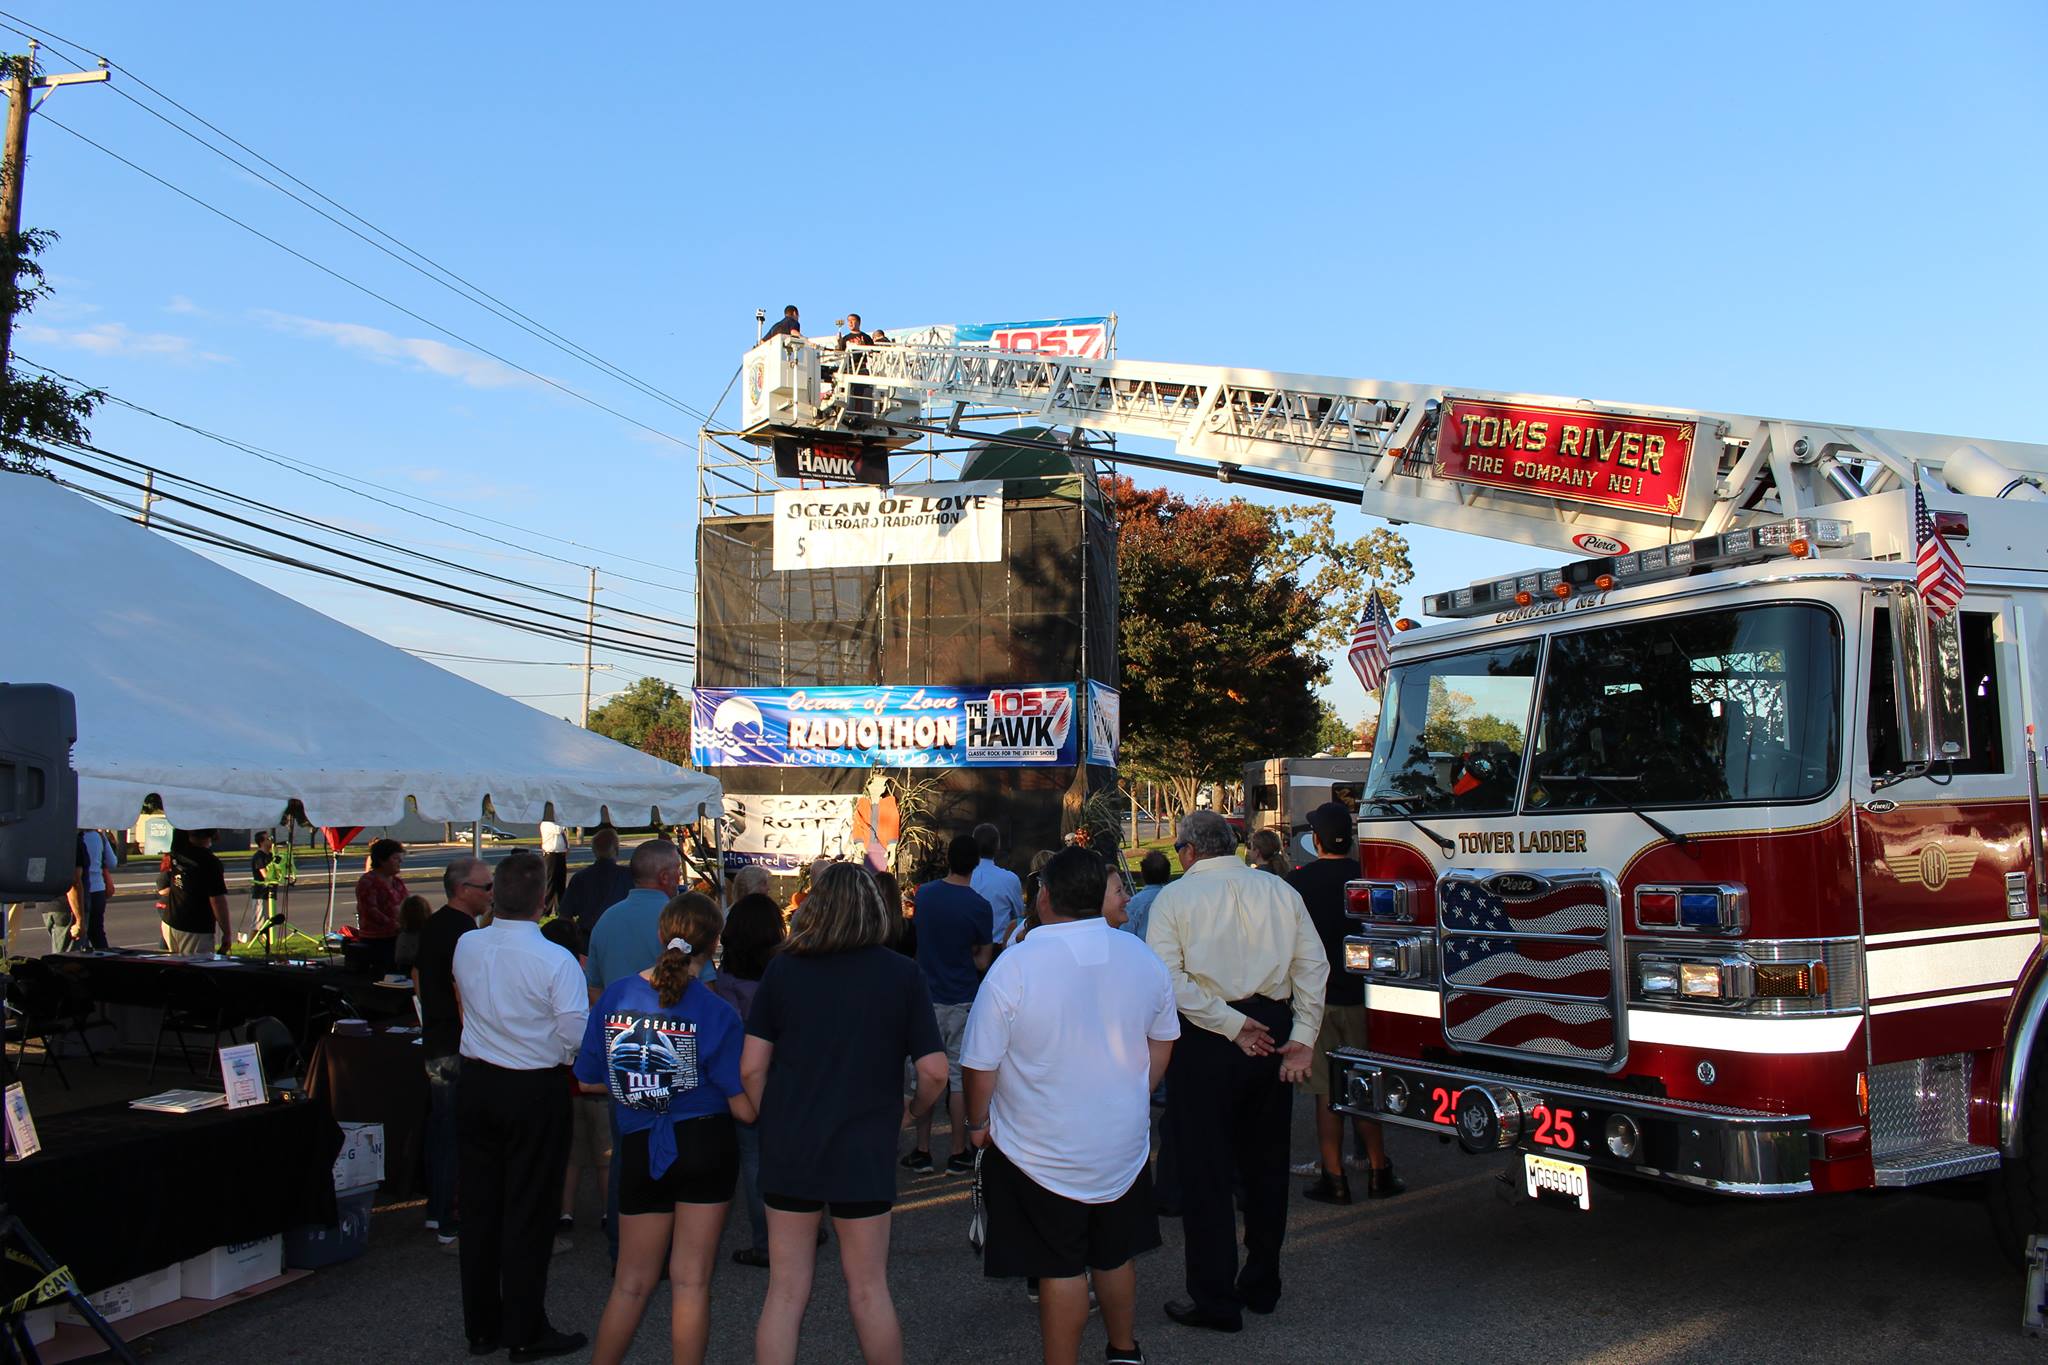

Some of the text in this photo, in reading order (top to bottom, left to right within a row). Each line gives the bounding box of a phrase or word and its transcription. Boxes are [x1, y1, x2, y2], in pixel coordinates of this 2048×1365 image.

[995, 327, 1102, 357] 105.7
[797, 447, 811, 456] THE
[1462, 413, 1667, 475] TOMS RIVER
[797, 454, 856, 476] HAWK
[1467, 454, 1504, 475] FIRE
[1513, 460, 1598, 489] COMPANY
[787, 494, 988, 519] OCEAN OF LOVE
[808, 517, 879, 531] BILLBOARD
[1583, 536, 1617, 552] Pierce
[786, 688, 957, 716] Ocean of Love
[967, 703, 988, 717] THE
[989, 690, 1067, 717] 105.7
[788, 716, 957, 750] RADIOTHON
[968, 716, 1056, 747] HAWK
[1458, 829, 1588, 854] TOWER LADDER
[729, 853, 780, 867] Haunted
[1500, 876, 1534, 892] Pierce
[643, 1018, 697, 1033] SEASON
[644, 1086, 670, 1098] YORK
[1532, 1103, 1576, 1149] 25
